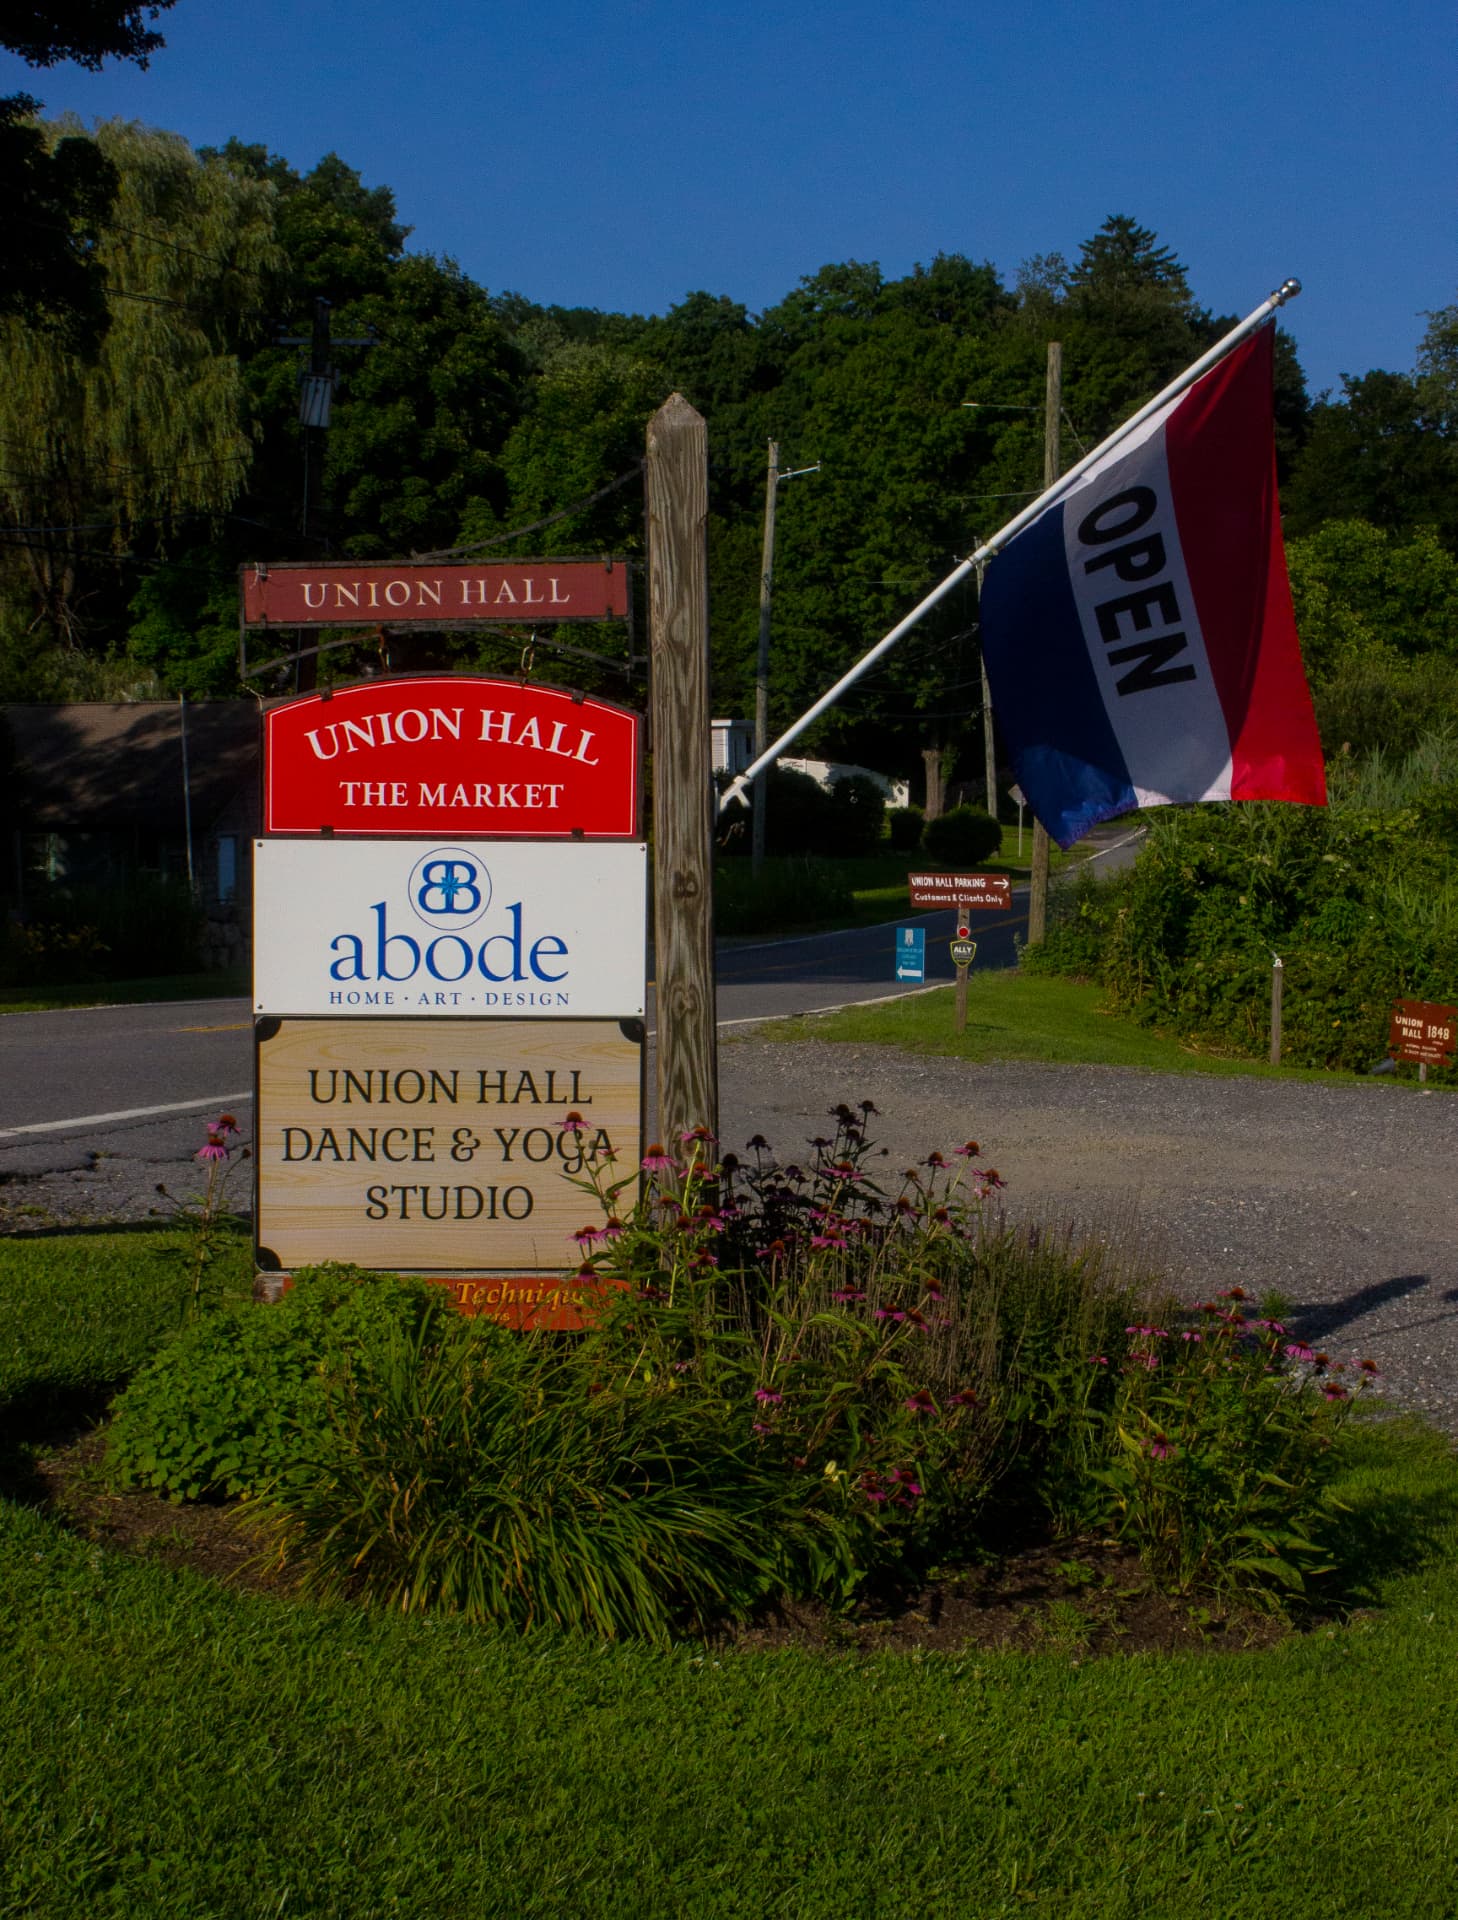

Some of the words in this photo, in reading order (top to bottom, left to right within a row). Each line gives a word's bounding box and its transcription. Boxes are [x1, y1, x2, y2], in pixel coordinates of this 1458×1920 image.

[301, 580, 443, 608] UNION
[460, 577, 571, 605] HALL
[1078, 486, 1197, 697] OPEN
[304, 707, 464, 761] UNION
[477, 709, 600, 767] HALL
[339, 781, 409, 807] THE
[417, 783, 565, 809] MARKET
[911, 876, 935, 887] UNION
[935, 877, 953, 888] HALL
[954, 877, 986, 888] PARKING
[914, 893, 951, 901] Customers
[958, 894, 984, 902] Clients
[985, 894, 1003, 905] Only
[329, 901, 570, 983] abode
[329, 991, 395, 1006] HOME
[418, 992, 463, 1006] ART
[485, 992, 570, 1007] DESIGN
[1395, 1015, 1423, 1028] UNION
[1402, 1027, 1422, 1039] HALL
[1427, 1025, 1449, 1039] 1848
[308, 1069, 459, 1104] UNION
[477, 1070, 593, 1104] HALL
[282, 1126, 436, 1162] DANCE
[451, 1127, 480, 1162] &
[365, 1185, 534, 1220] STUDIO
